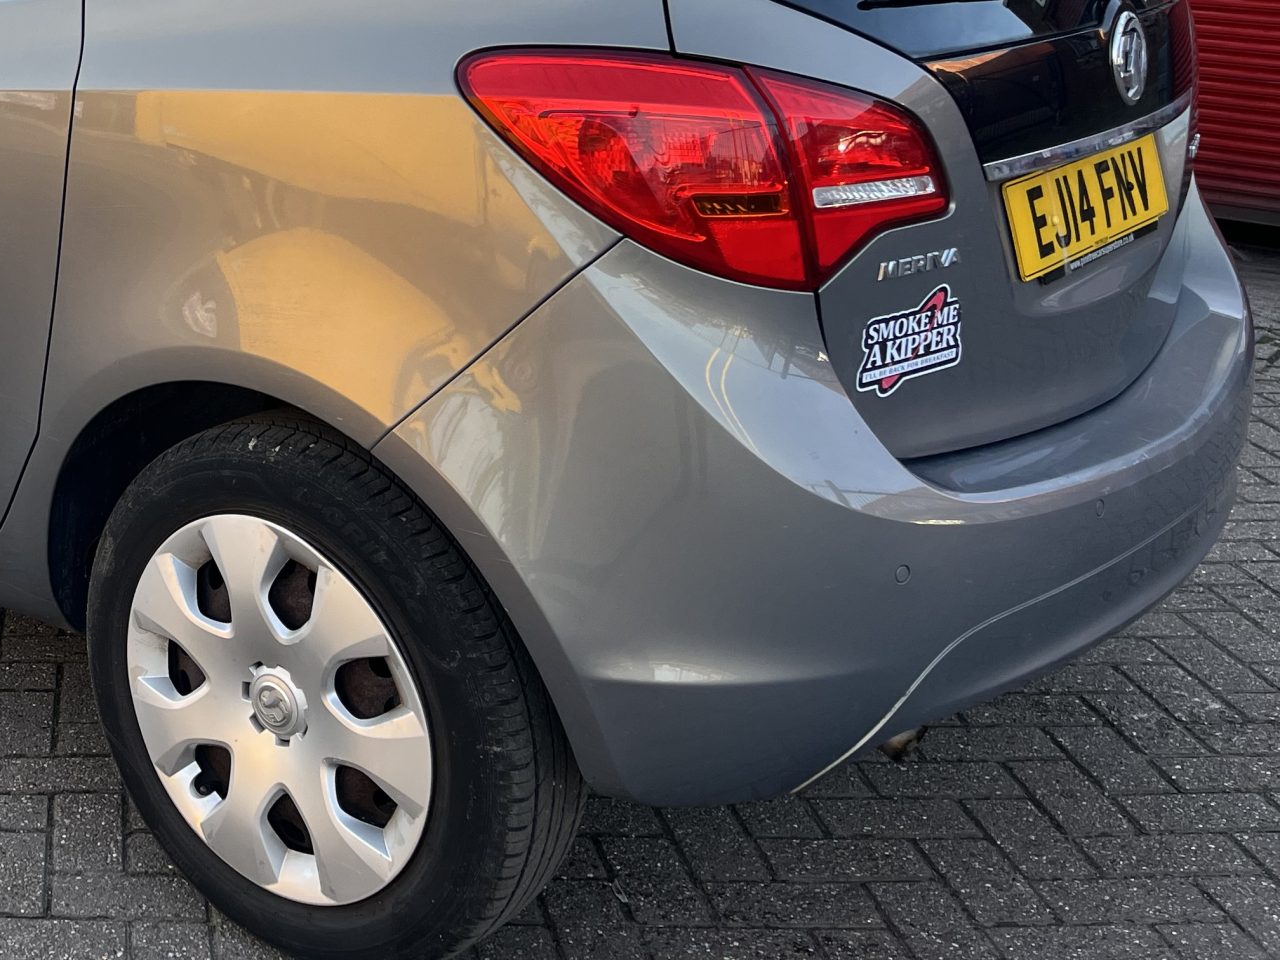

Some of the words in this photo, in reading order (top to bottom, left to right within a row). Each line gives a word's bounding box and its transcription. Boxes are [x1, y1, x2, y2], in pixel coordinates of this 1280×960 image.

[1026, 169, 1096, 259] EJ14
[1094, 147, 1149, 228] FNV
[877, 247, 962, 281] MERIVA
[868, 310, 932, 344] SMOKE
[933, 303, 960, 328] ME
[866, 340, 883, 369] A
[884, 324, 956, 364] KIPPER
[889, 365, 906, 375] BACK
[907, 361, 919, 370] FOR
[920, 350, 955, 366] BREAKFAST
